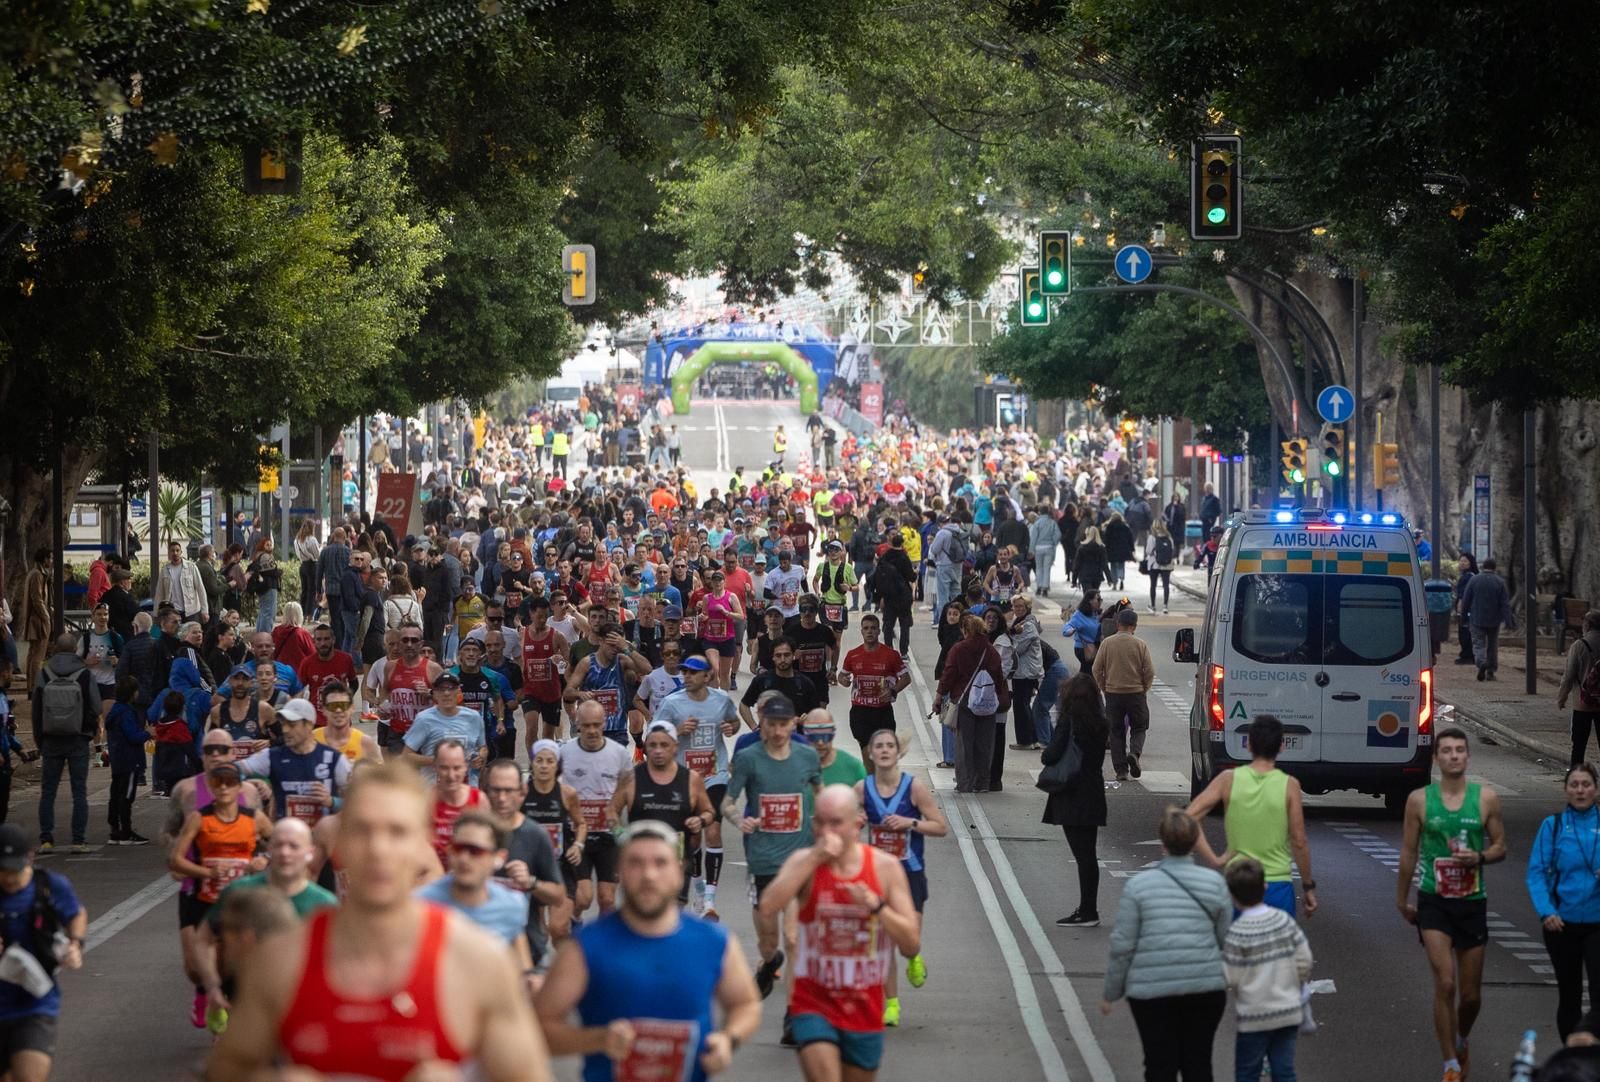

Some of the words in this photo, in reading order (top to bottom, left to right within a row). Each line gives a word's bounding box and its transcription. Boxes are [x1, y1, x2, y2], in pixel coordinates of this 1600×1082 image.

[865, 394, 880, 406] 42
[383, 498, 406, 518] 22
[1272, 533, 1378, 548] AMBULANCIA
[1230, 670, 1307, 682] URGENCIAS
[1390, 673, 1410, 686] ssg
[695, 728, 713, 736] NB
[695, 736, 713, 745] RC
